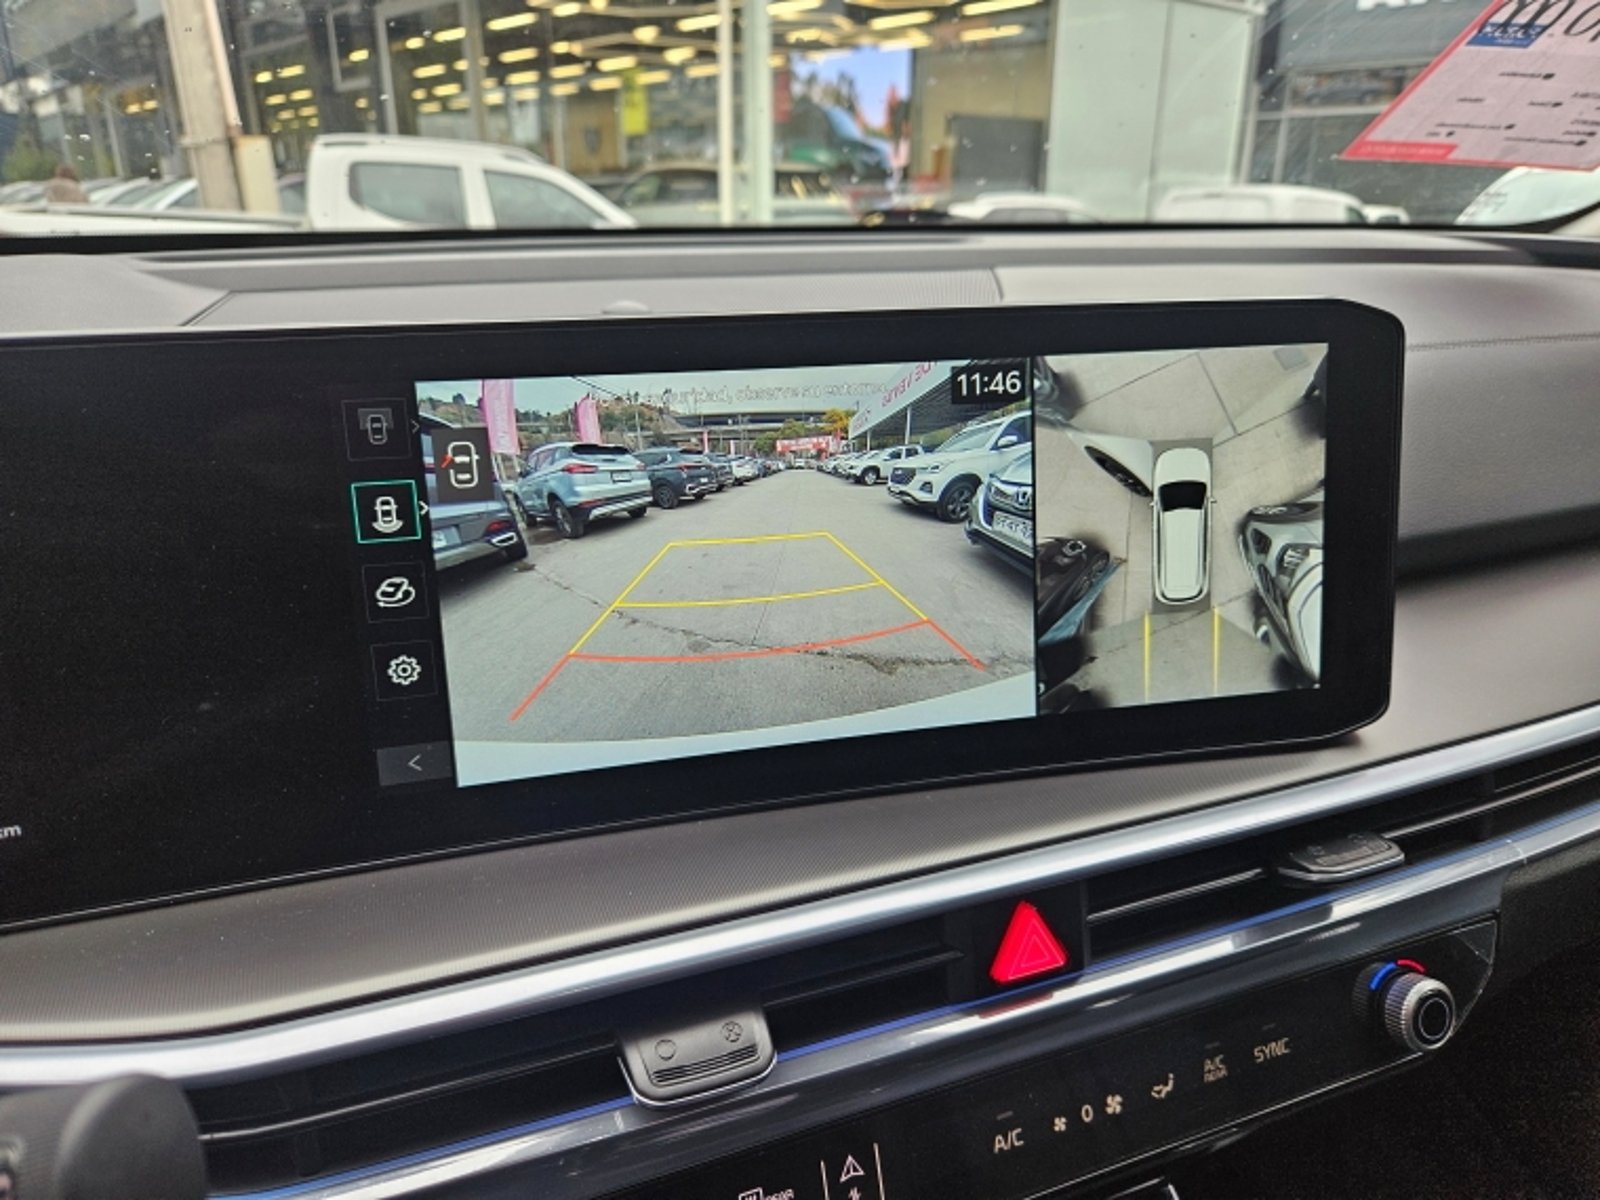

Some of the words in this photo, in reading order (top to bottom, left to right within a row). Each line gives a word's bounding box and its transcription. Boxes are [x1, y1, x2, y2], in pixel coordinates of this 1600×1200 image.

[957, 370, 1021, 396] 11:46
[1254, 1037, 1291, 1064] SYNC
[993, 1127, 1024, 1154] A/C
